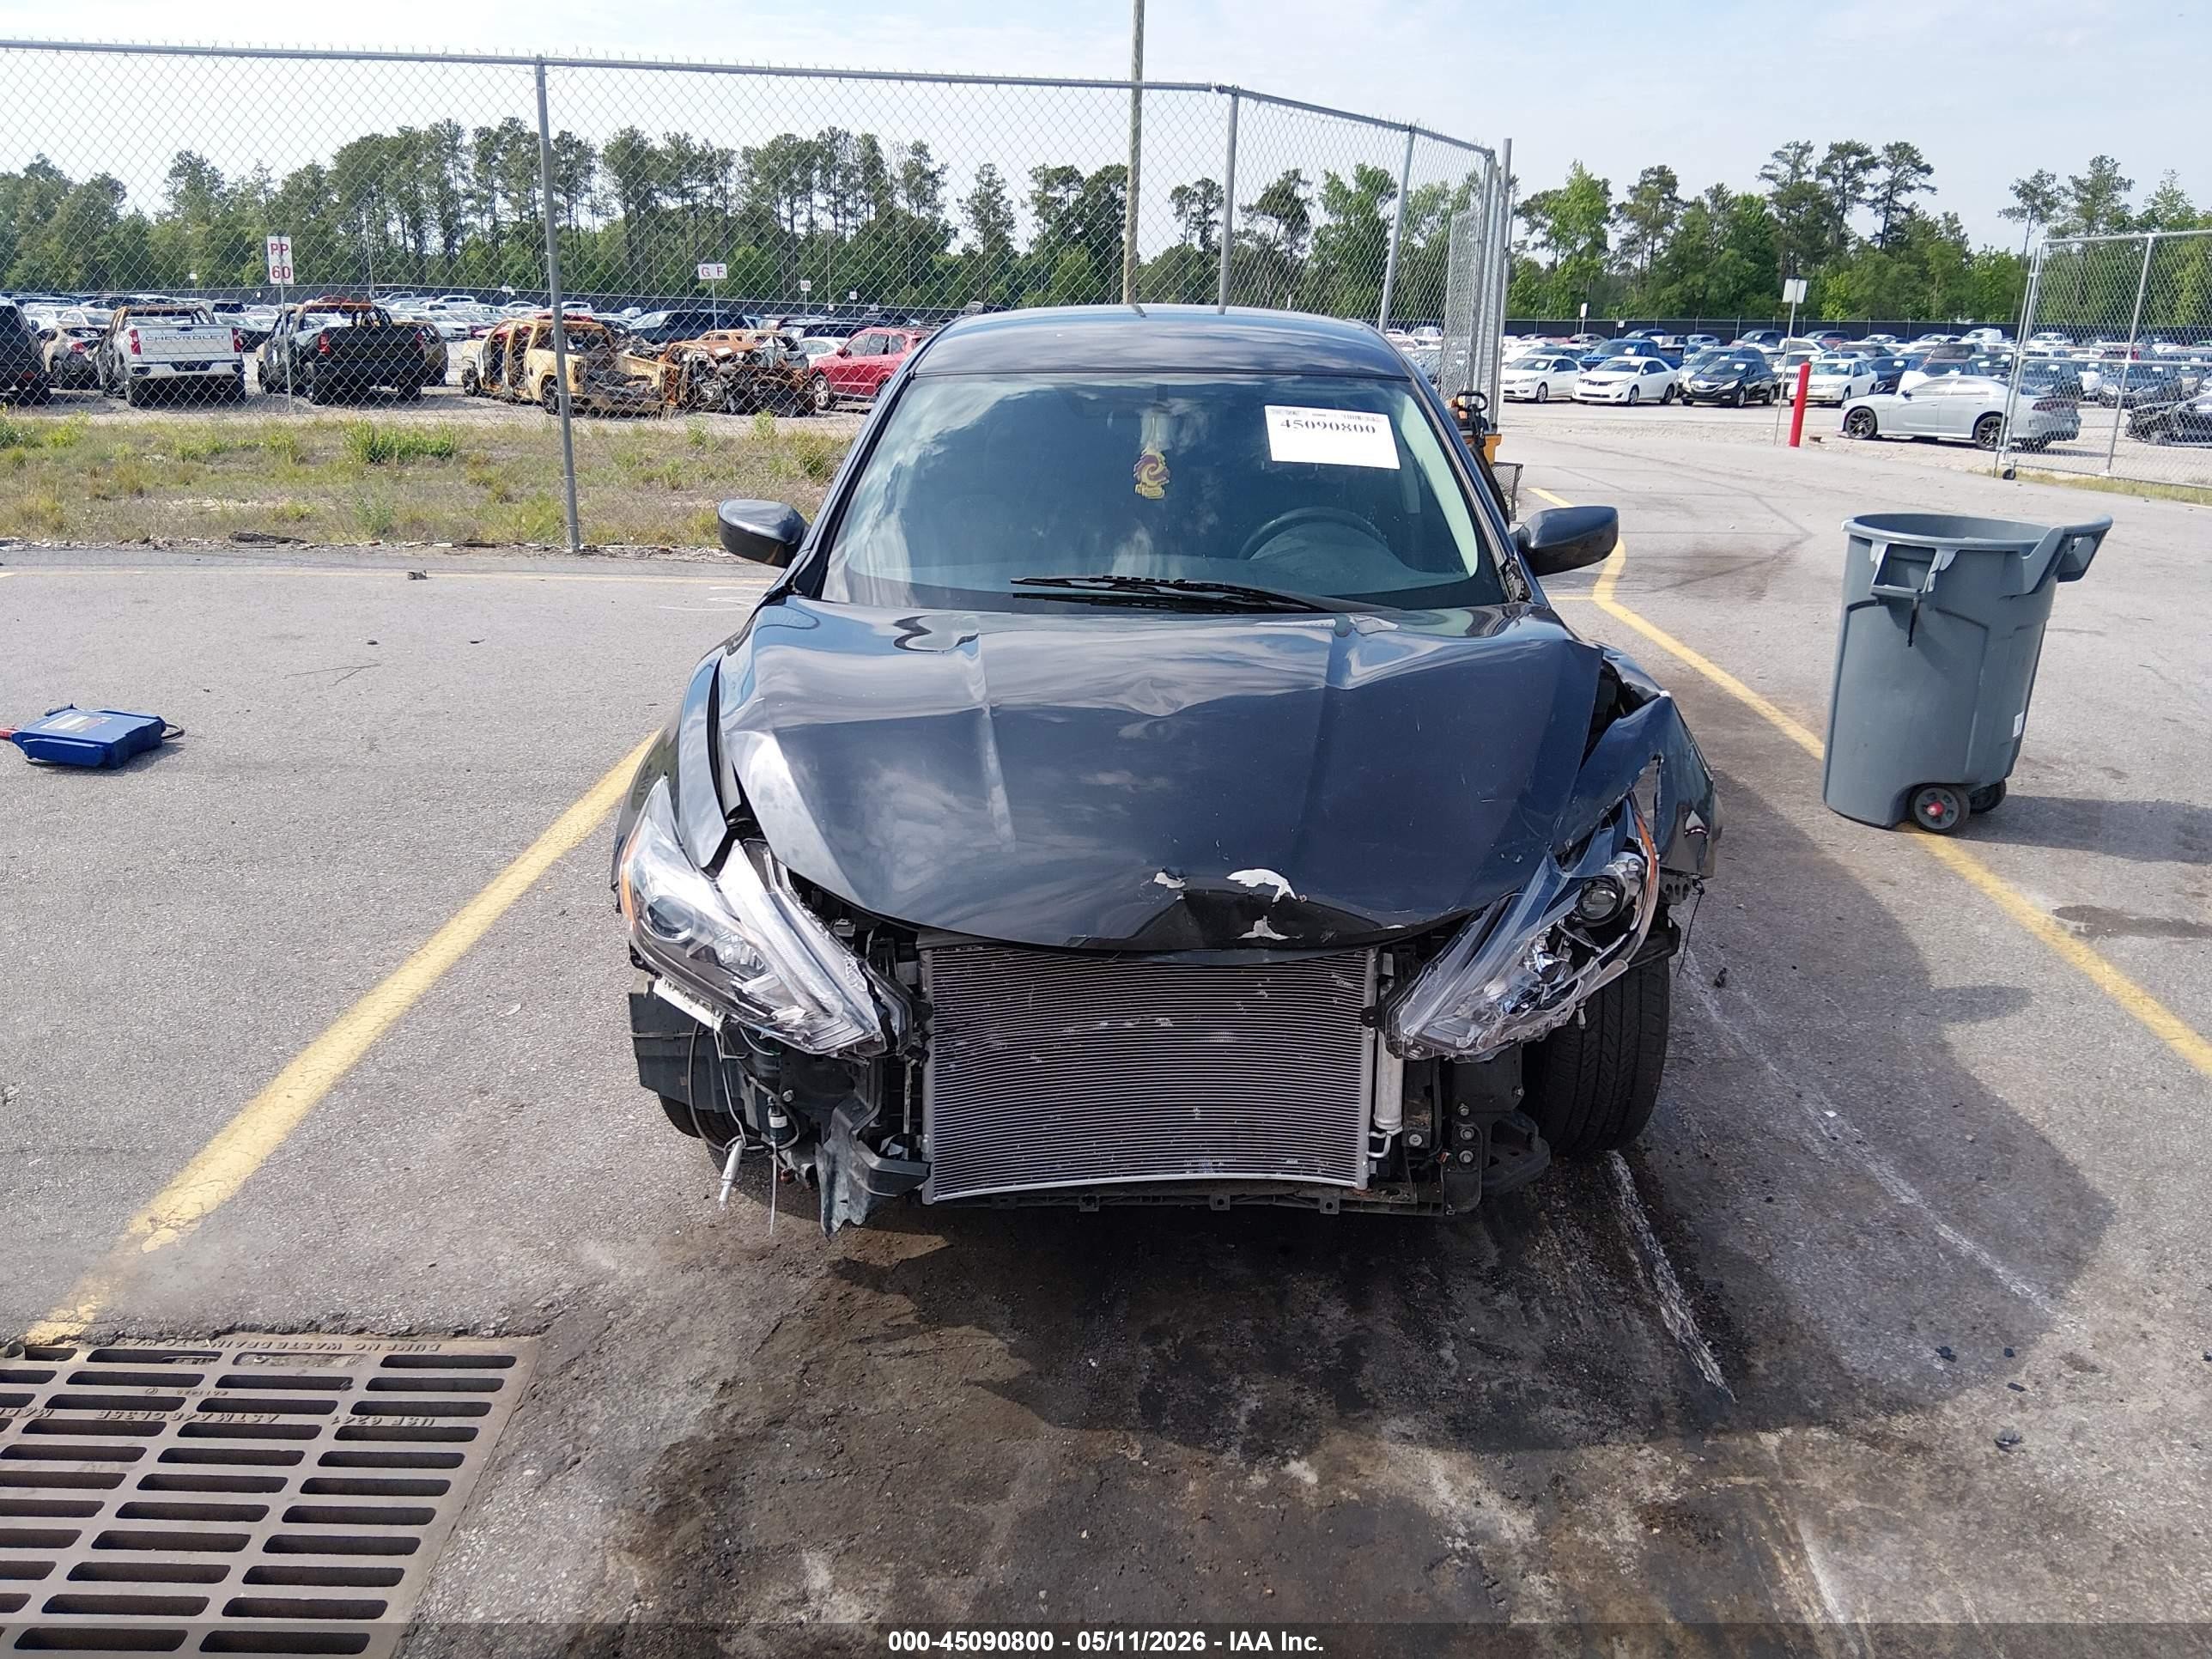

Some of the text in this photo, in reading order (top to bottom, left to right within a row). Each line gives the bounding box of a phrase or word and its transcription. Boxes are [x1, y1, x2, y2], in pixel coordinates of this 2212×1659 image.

[270, 243, 289, 255] PP
[271, 265, 291, 279] 60
[1280, 419, 1376, 434] 45090800
